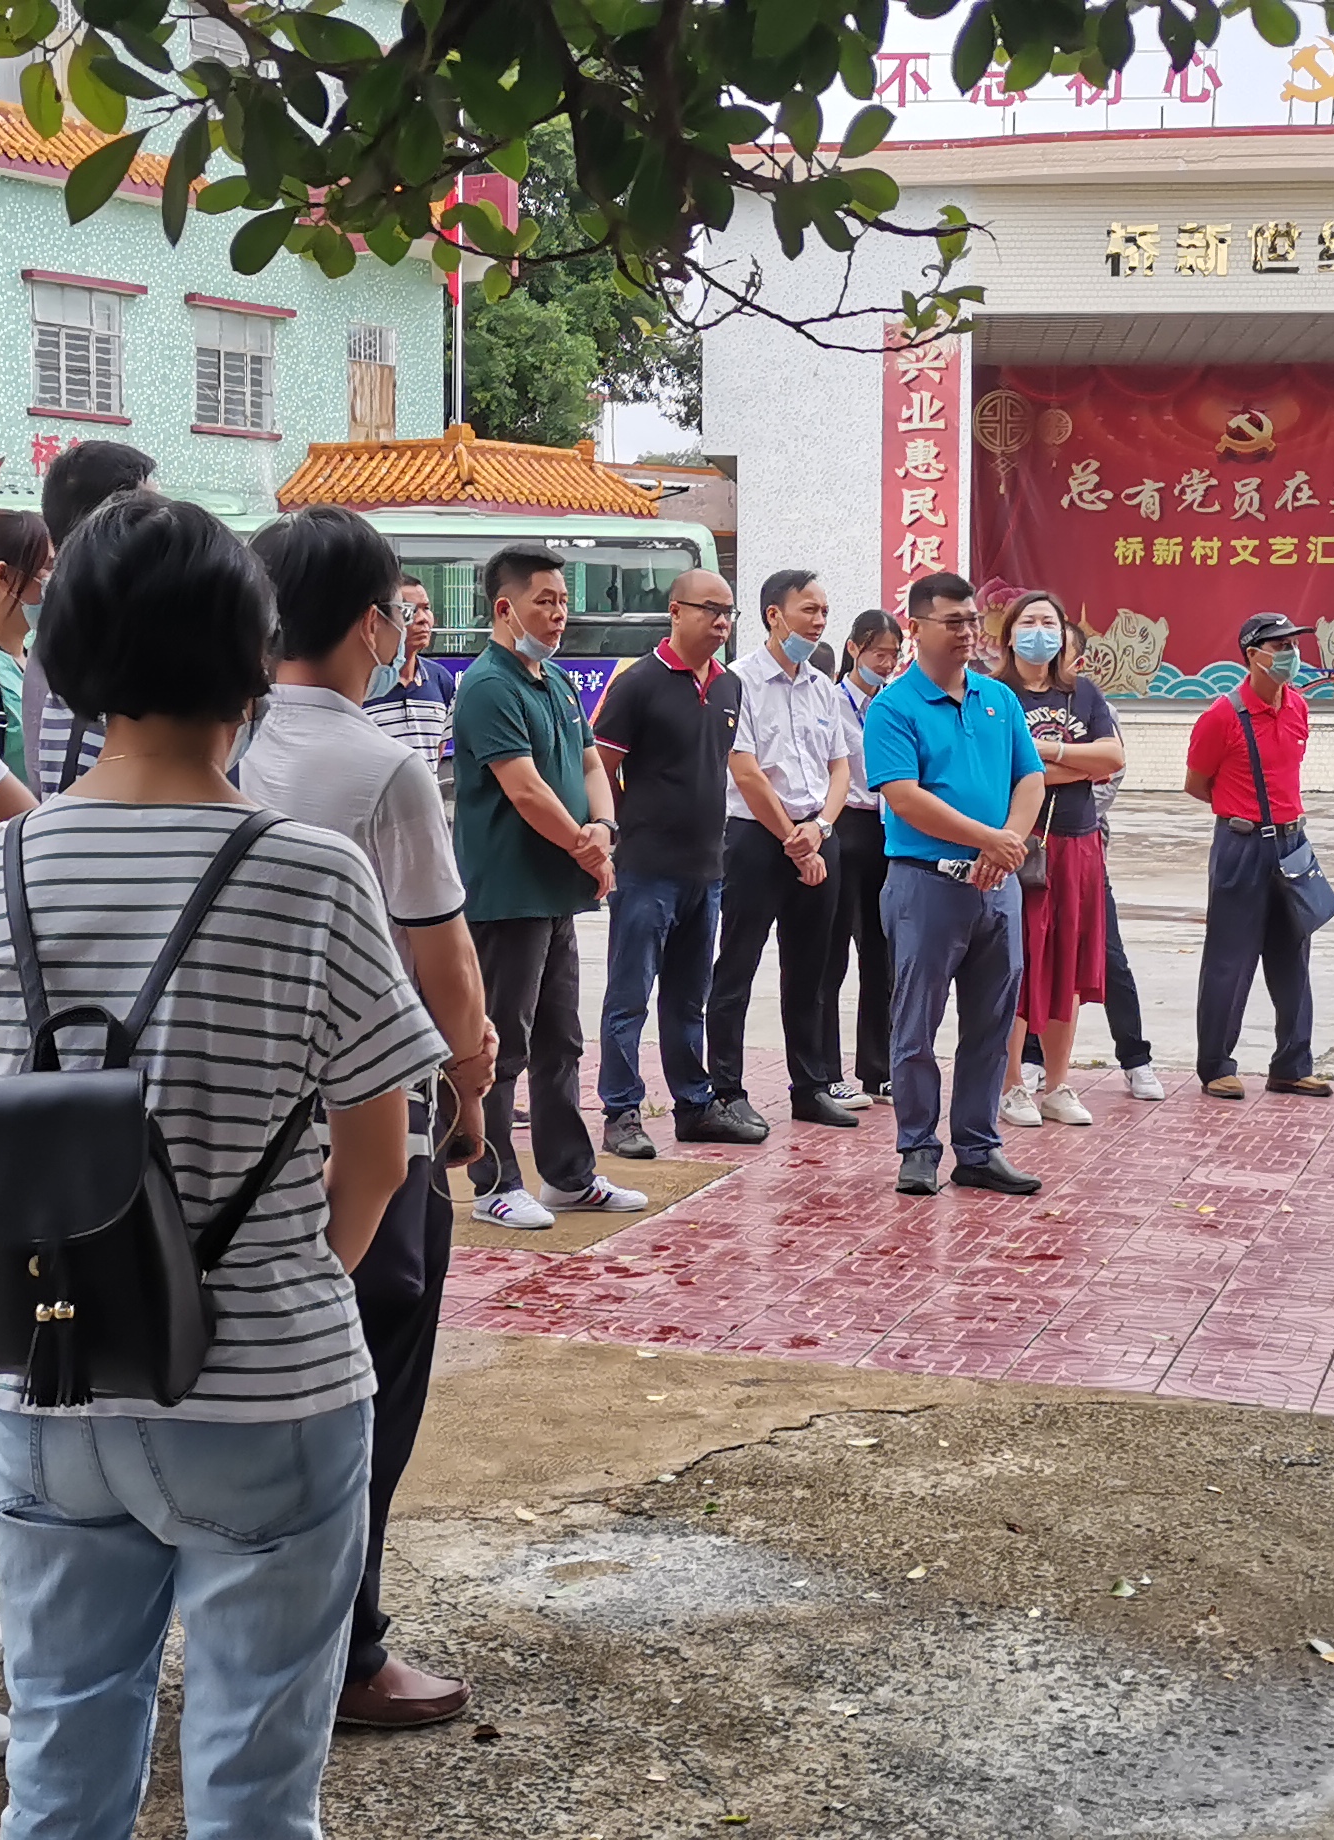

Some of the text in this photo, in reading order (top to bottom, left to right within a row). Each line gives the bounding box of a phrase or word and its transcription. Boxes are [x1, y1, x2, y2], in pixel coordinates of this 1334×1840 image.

[893, 347, 948, 662] 兴业惠民促
